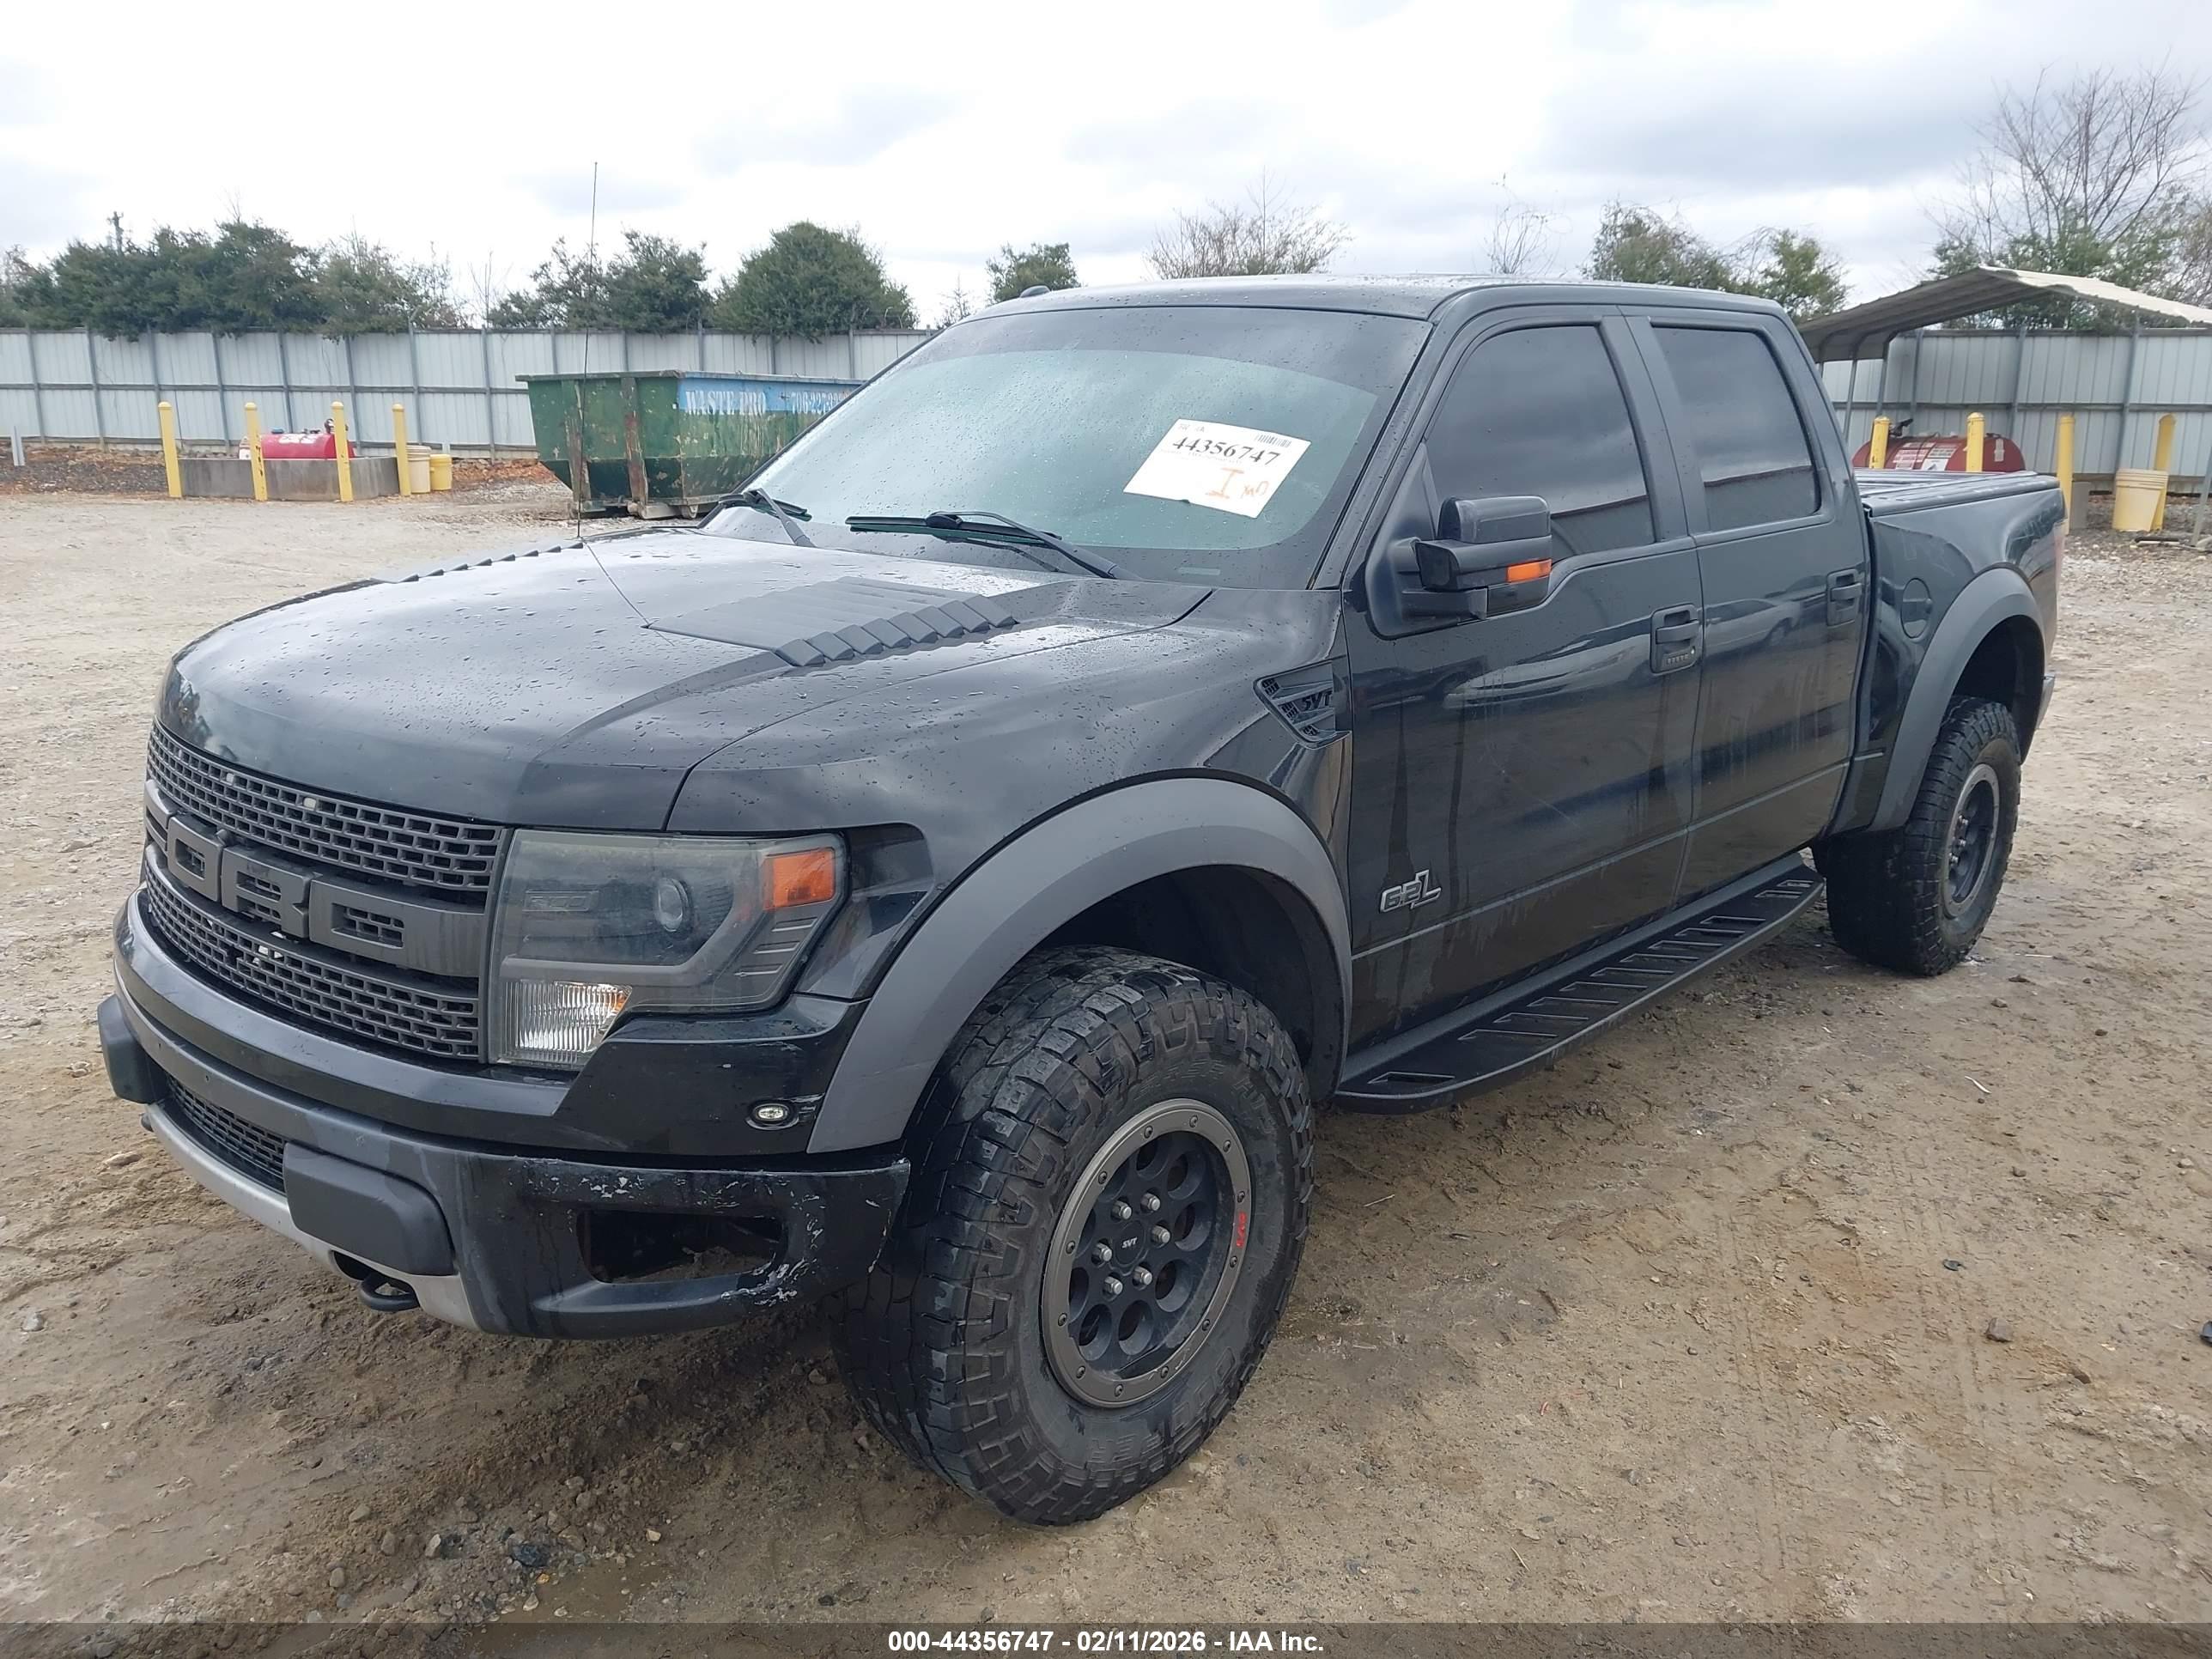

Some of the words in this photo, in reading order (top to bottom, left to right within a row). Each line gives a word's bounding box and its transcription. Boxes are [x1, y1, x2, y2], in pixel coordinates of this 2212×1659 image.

[685, 390, 735, 416] WASTE
[739, 391, 767, 416] PRO
[1173, 436, 1281, 465] 44356747
[1121, 1237, 1138, 1249] SVT
